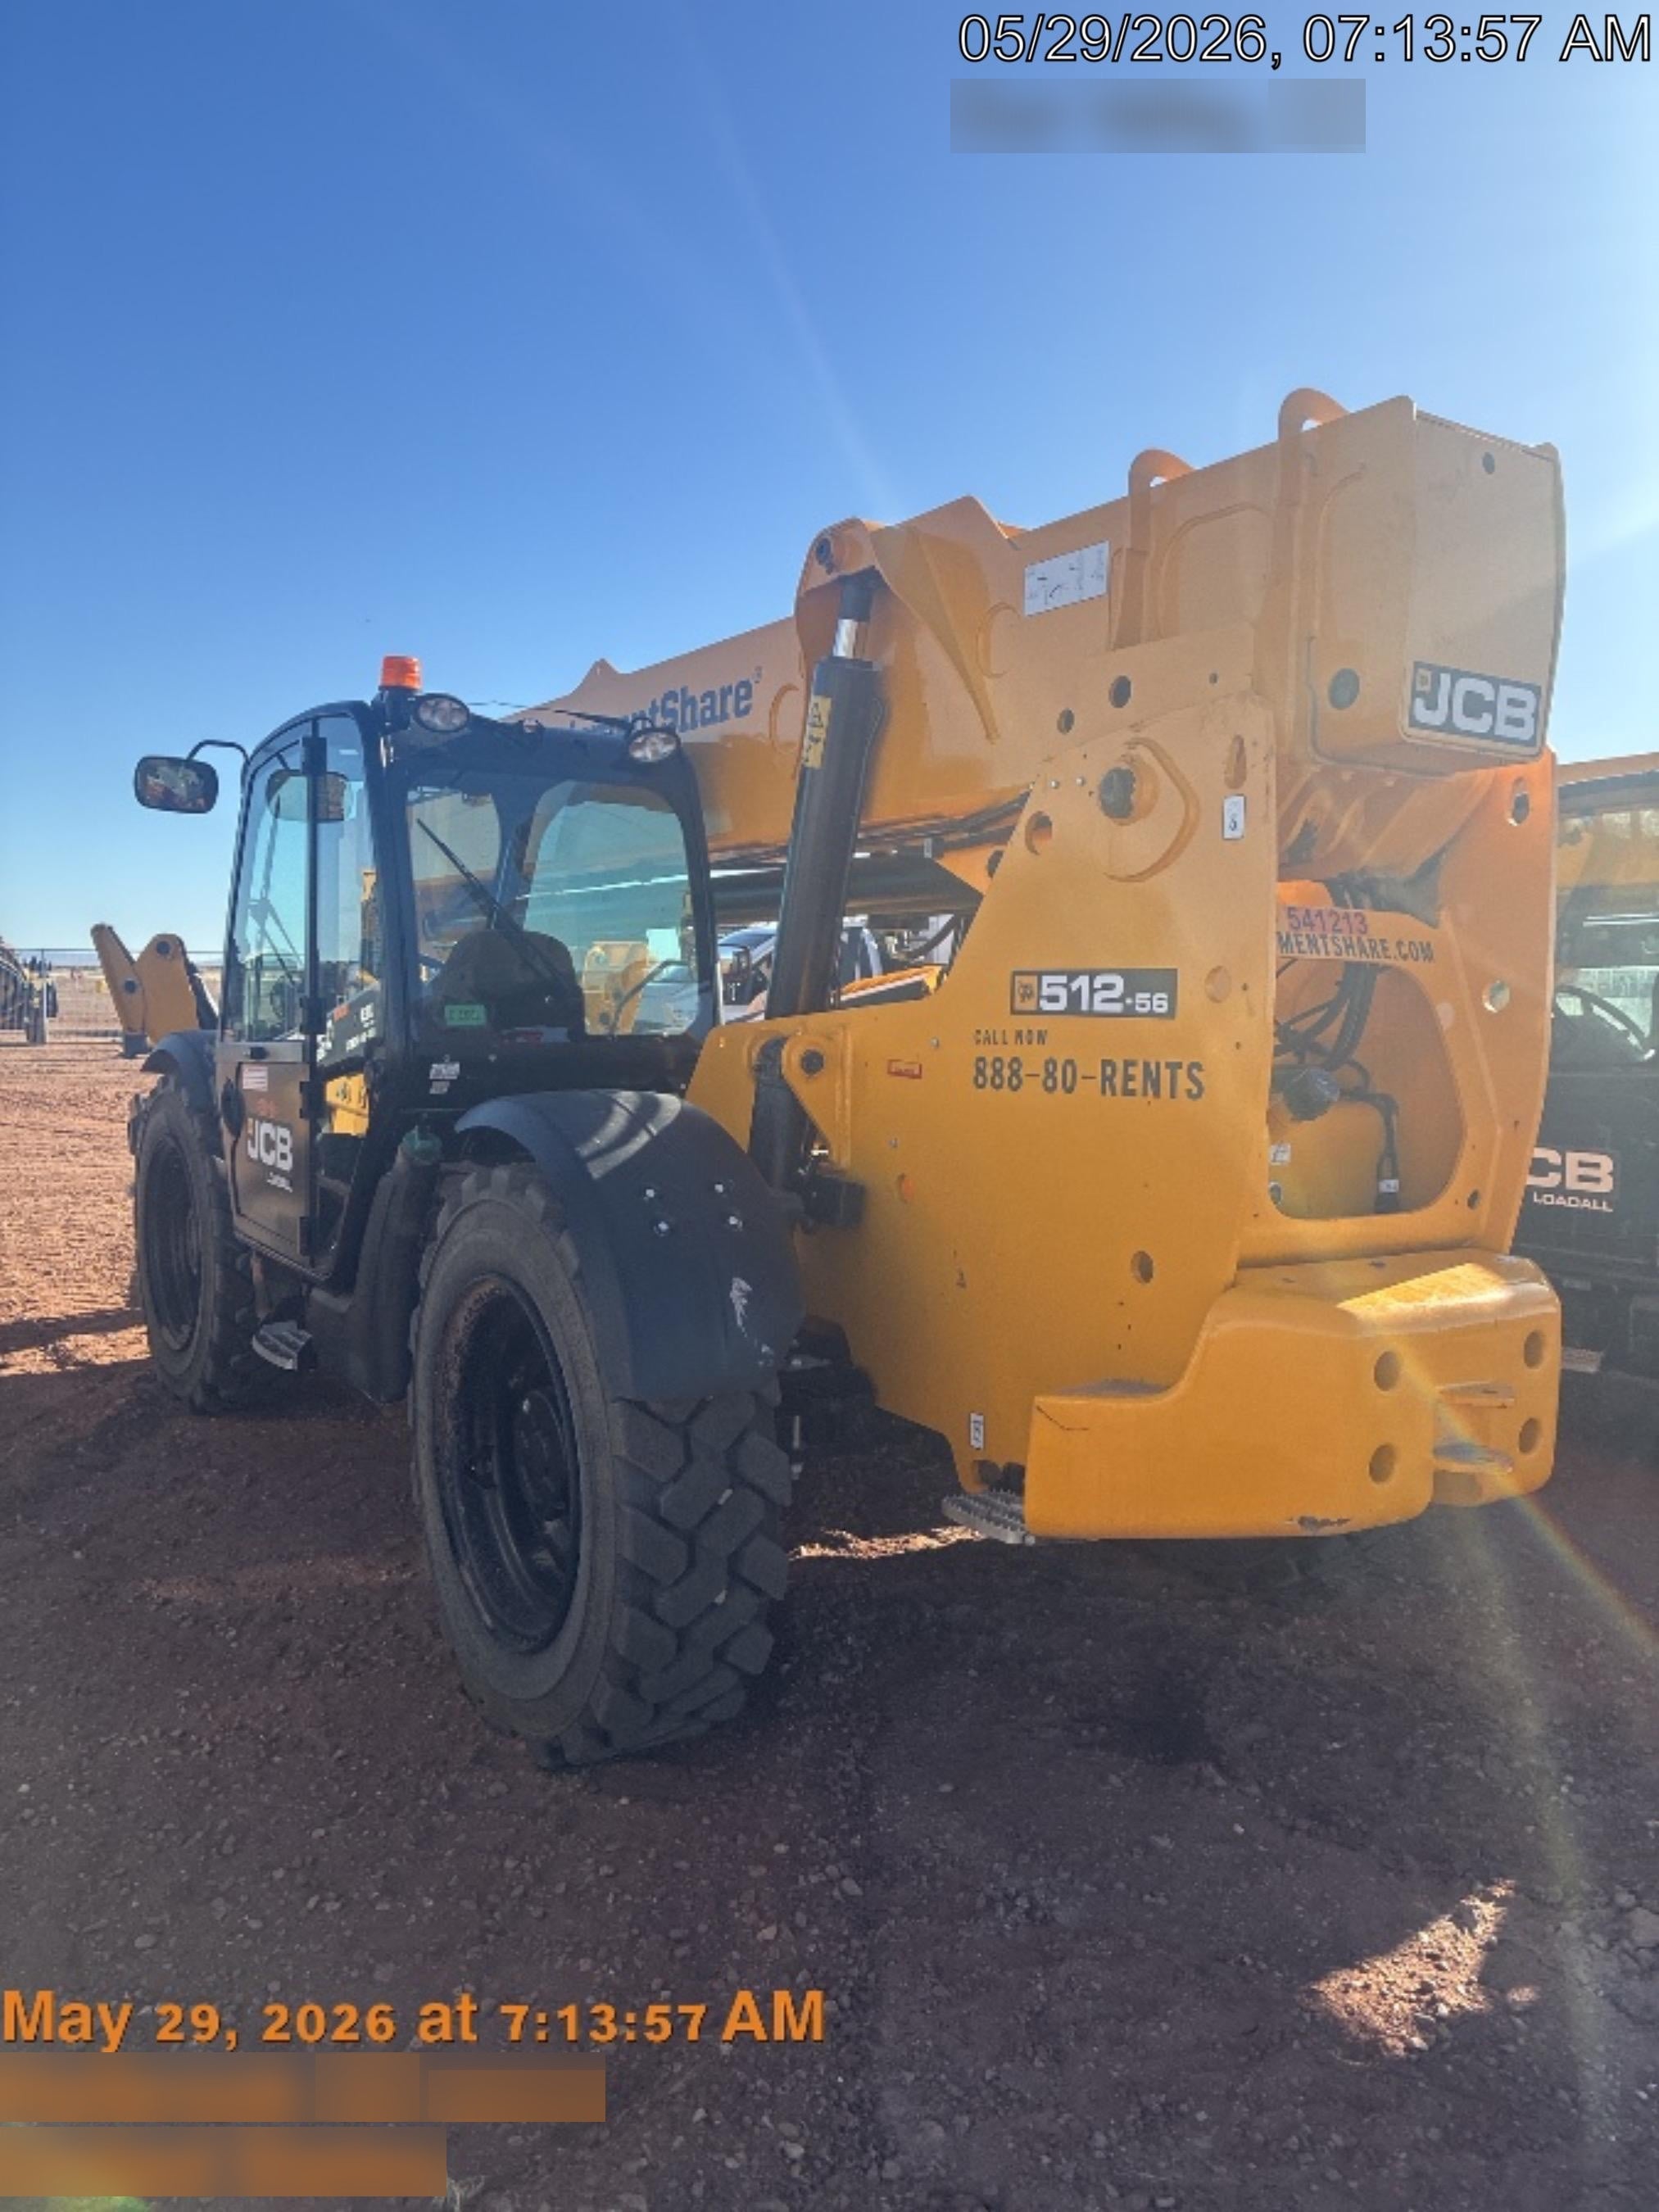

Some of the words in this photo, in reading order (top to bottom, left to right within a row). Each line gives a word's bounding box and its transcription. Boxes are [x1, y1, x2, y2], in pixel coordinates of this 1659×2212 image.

[1413, 673, 1537, 741] JCB
[1287, 906, 1368, 935] 541213
[975, 1029, 1009, 1045] CALL
[1015, 1030, 1048, 1045] NOW
[973, 1056, 1204, 1100] 888-80-RENTS
[247, 1117, 293, 1172] JCB
[1526, 1147, 1613, 1193] CB
[1533, 1191, 1613, 1213] LOADALL
